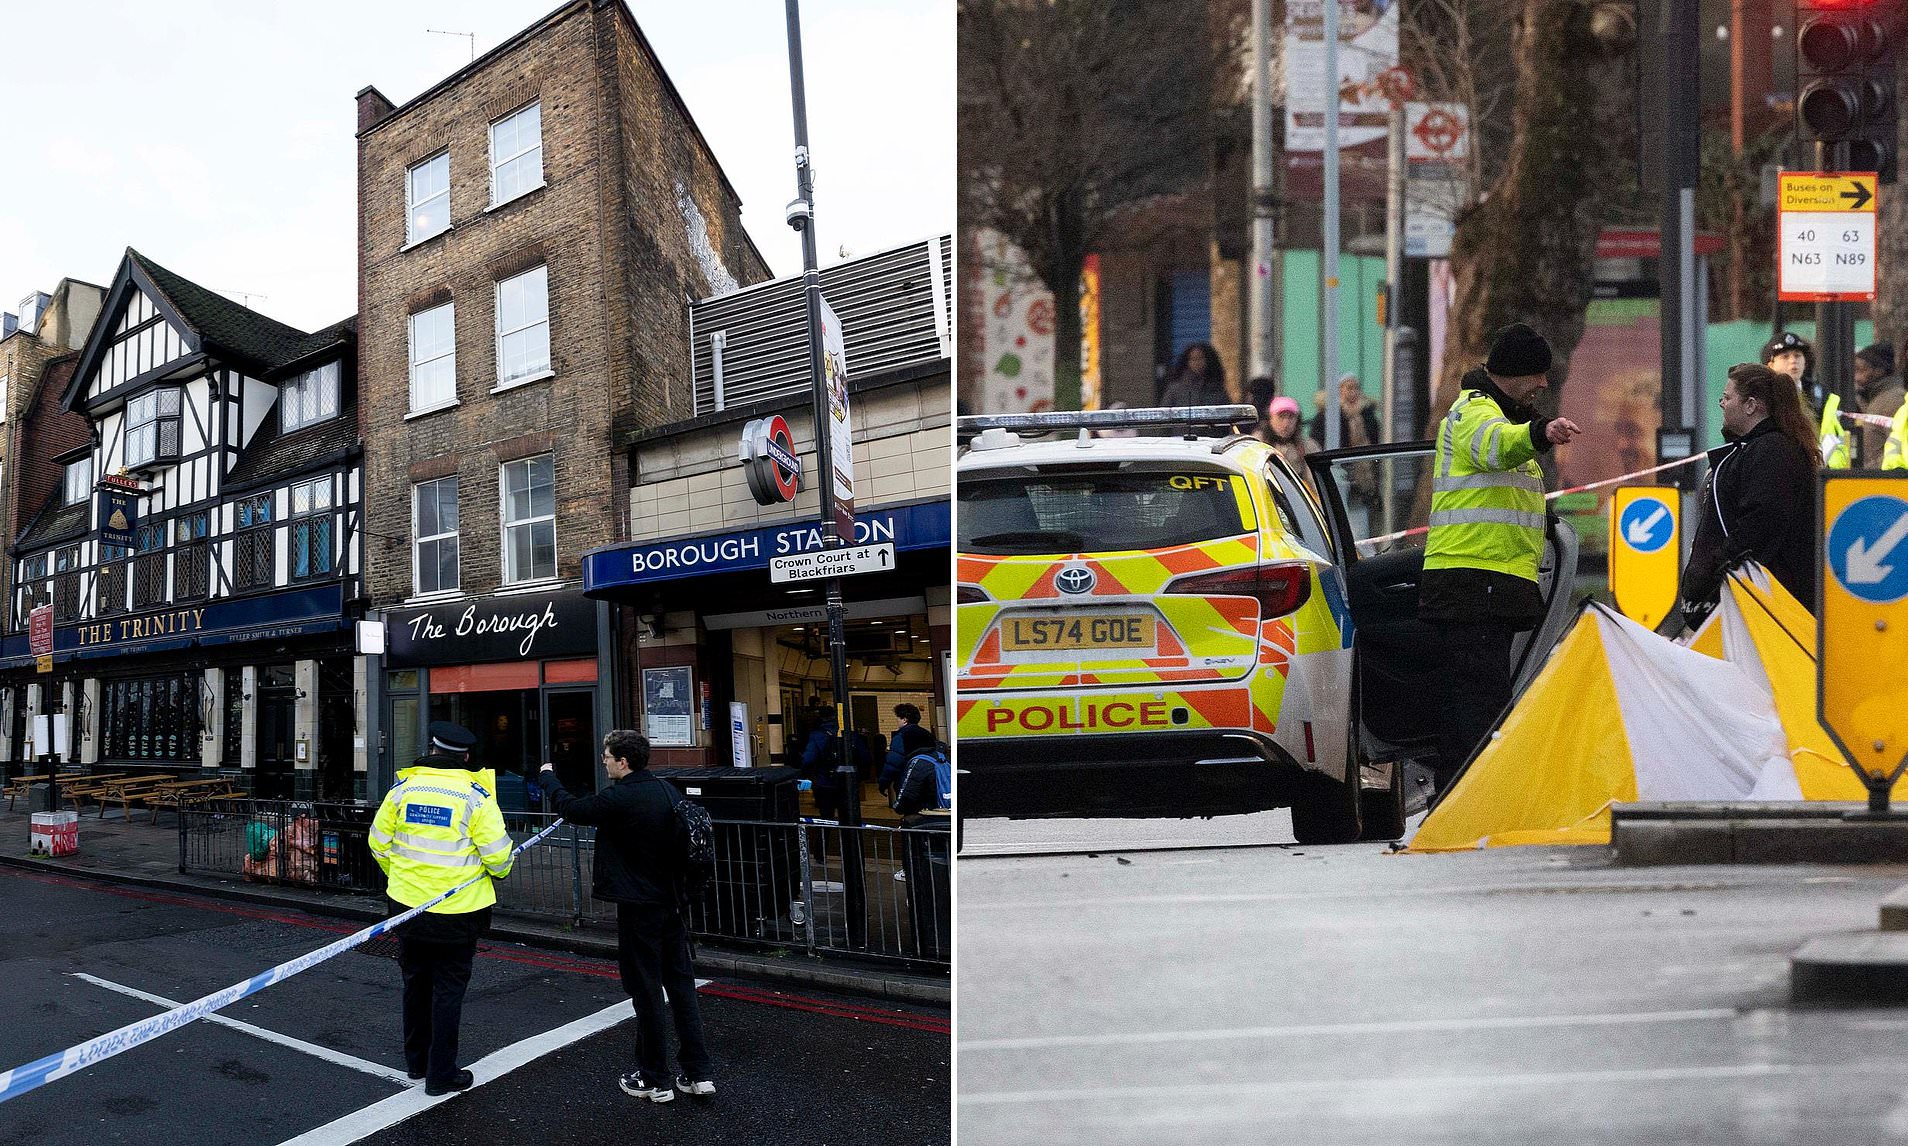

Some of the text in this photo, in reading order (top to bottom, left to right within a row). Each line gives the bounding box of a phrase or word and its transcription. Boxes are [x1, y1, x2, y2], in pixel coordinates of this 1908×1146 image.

[1786, 183, 1833, 192] Buses on
[1786, 195, 1835, 204] Diversion
[1797, 229, 1859, 242] 40 63
[1791, 252, 1866, 265] N63 N89
[1169, 476, 1228, 491] QFT
[103, 532, 133, 542] TRINITY
[632, 517, 895, 573] BOROUGH STAON
[775, 548, 870, 569] Crown Court at
[789, 563, 856, 579] Blackfriars
[766, 609, 822, 621] Northern
[78, 623, 112, 645] THE
[120, 608, 205, 640] TRINITY
[408, 601, 559, 656] The Borough
[1014, 617, 1143, 646] LS74 GOE
[986, 701, 1169, 733] POLICE
[418, 806, 441, 815] POLICE
